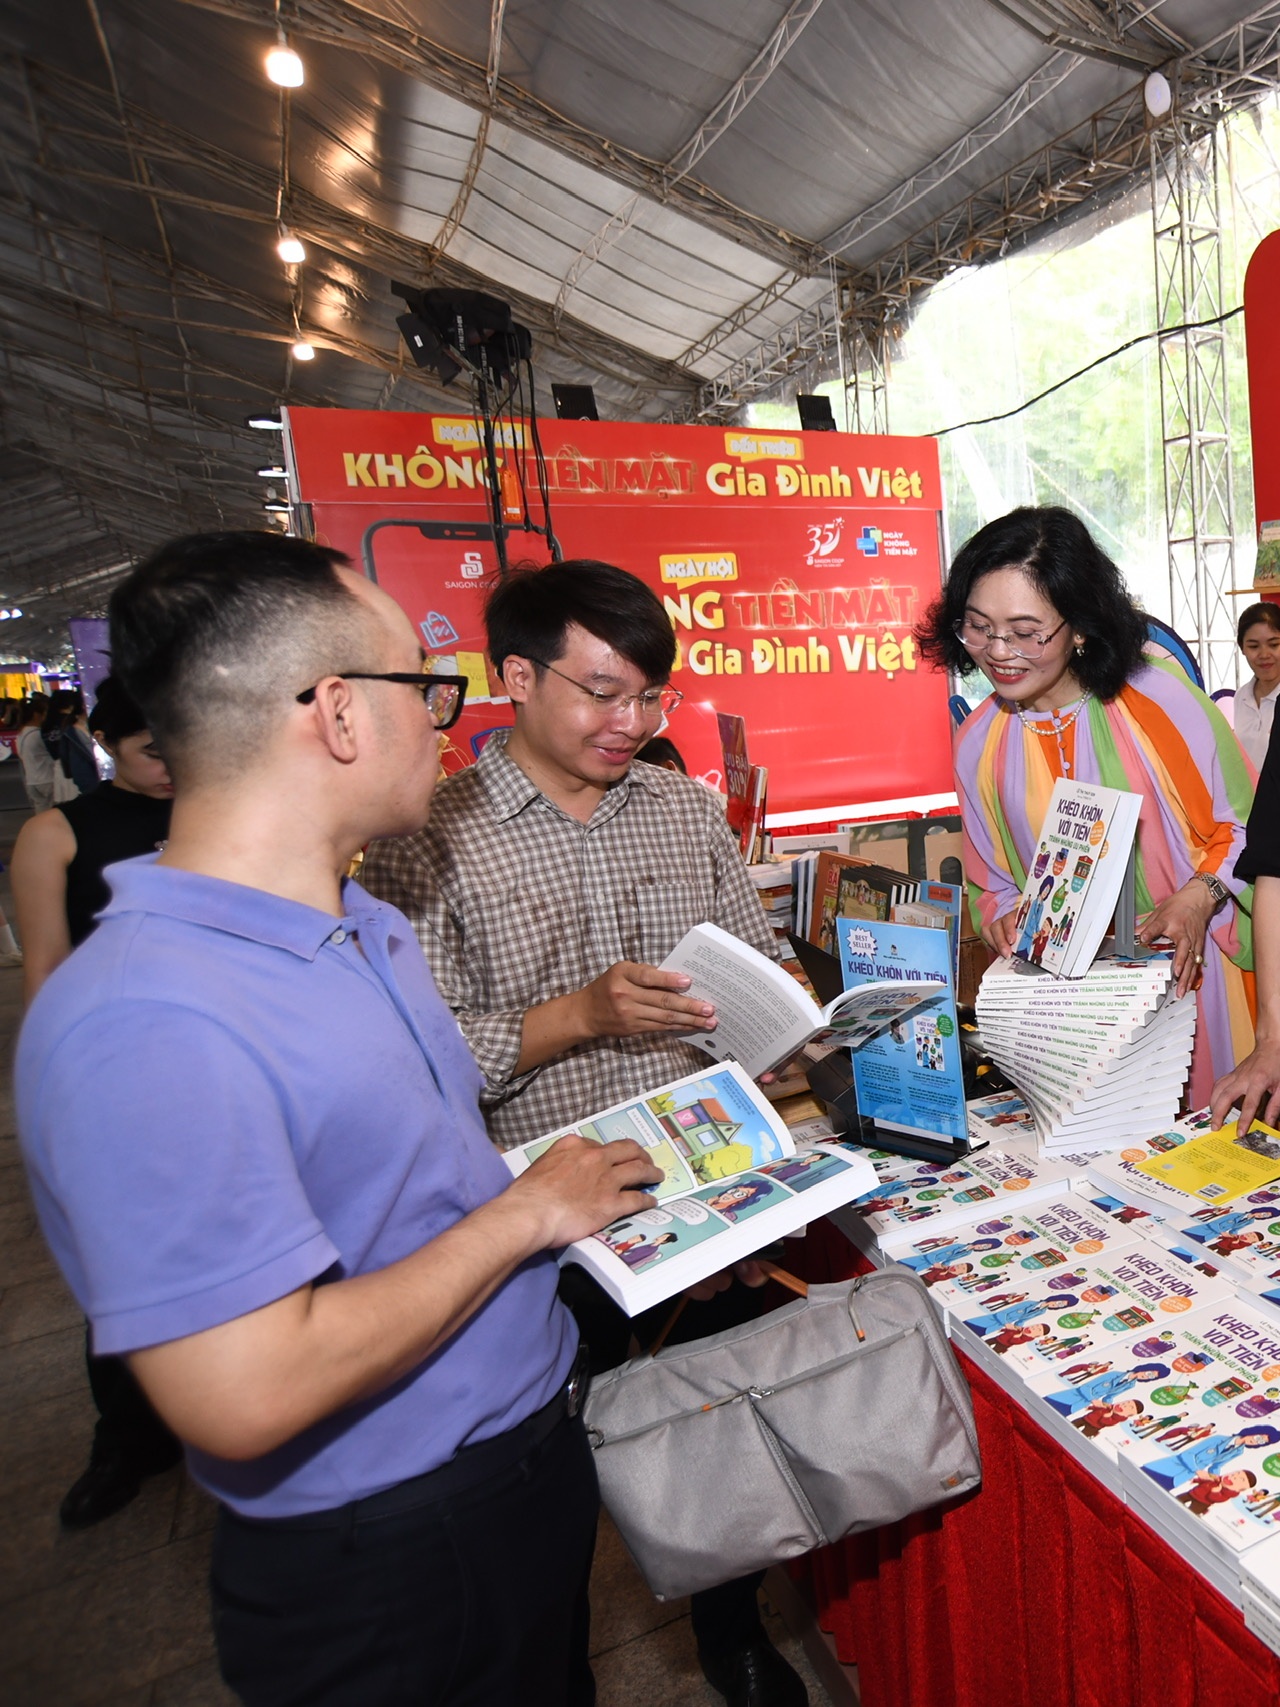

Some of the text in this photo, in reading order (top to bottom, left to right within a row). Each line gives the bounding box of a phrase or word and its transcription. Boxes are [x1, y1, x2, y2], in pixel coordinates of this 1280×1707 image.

[706, 463, 767, 496] Gia
[776, 465, 852, 497] Đình
[857, 466, 923, 504] Việt
[883, 531, 903, 539] NGÀY
[664, 557, 733, 578] NGÀY HỘI
[732, 577, 827, 630] TIỀN
[689, 633, 917, 679] Gia Đình Việt
[1057, 798, 1103, 822] KHÉO KHÔN
[1058, 818, 1091, 842] VỚI TIỀN
[853, 941, 872, 949] SELLER
[848, 960, 874, 976] KHÉO
[877, 964, 902, 981] KHÔN
[905, 968, 922, 981] VỚI
[1112, 1265, 1168, 1301] VỚI TIỀN
[1124, 1253, 1198, 1298] KHÉO KHÔN
[1212, 1313, 1260, 1340] KHÉO
[1203, 1328, 1270, 1371] VỚI TIỀN
